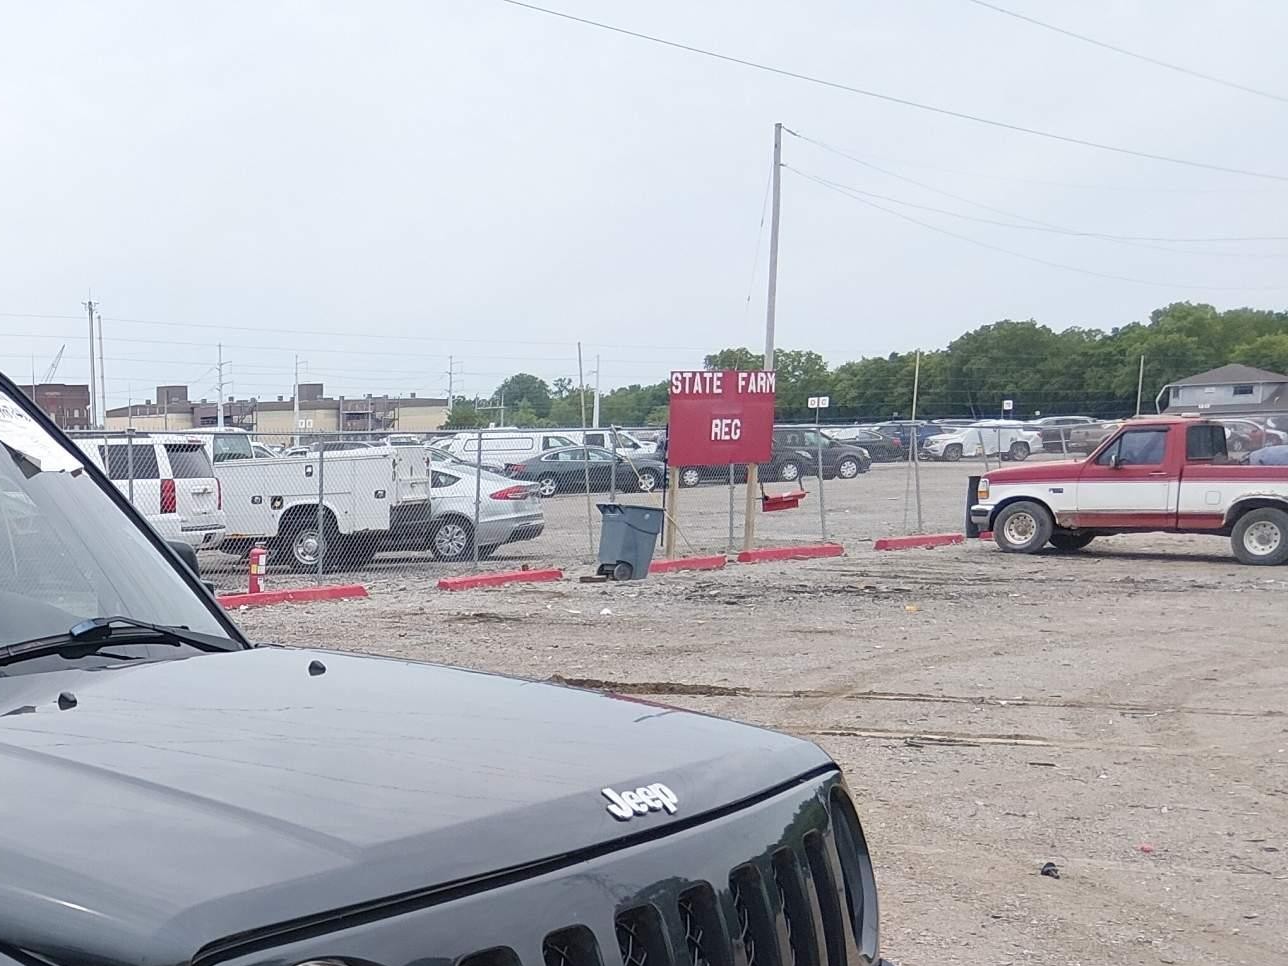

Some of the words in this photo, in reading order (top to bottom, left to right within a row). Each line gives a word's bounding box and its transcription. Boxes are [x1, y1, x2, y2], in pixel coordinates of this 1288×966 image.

[672, 372, 723, 394] STATE
[738, 372, 776, 394] FARM
[711, 419, 741, 441] REG
[601, 783, 679, 819] Jeep
